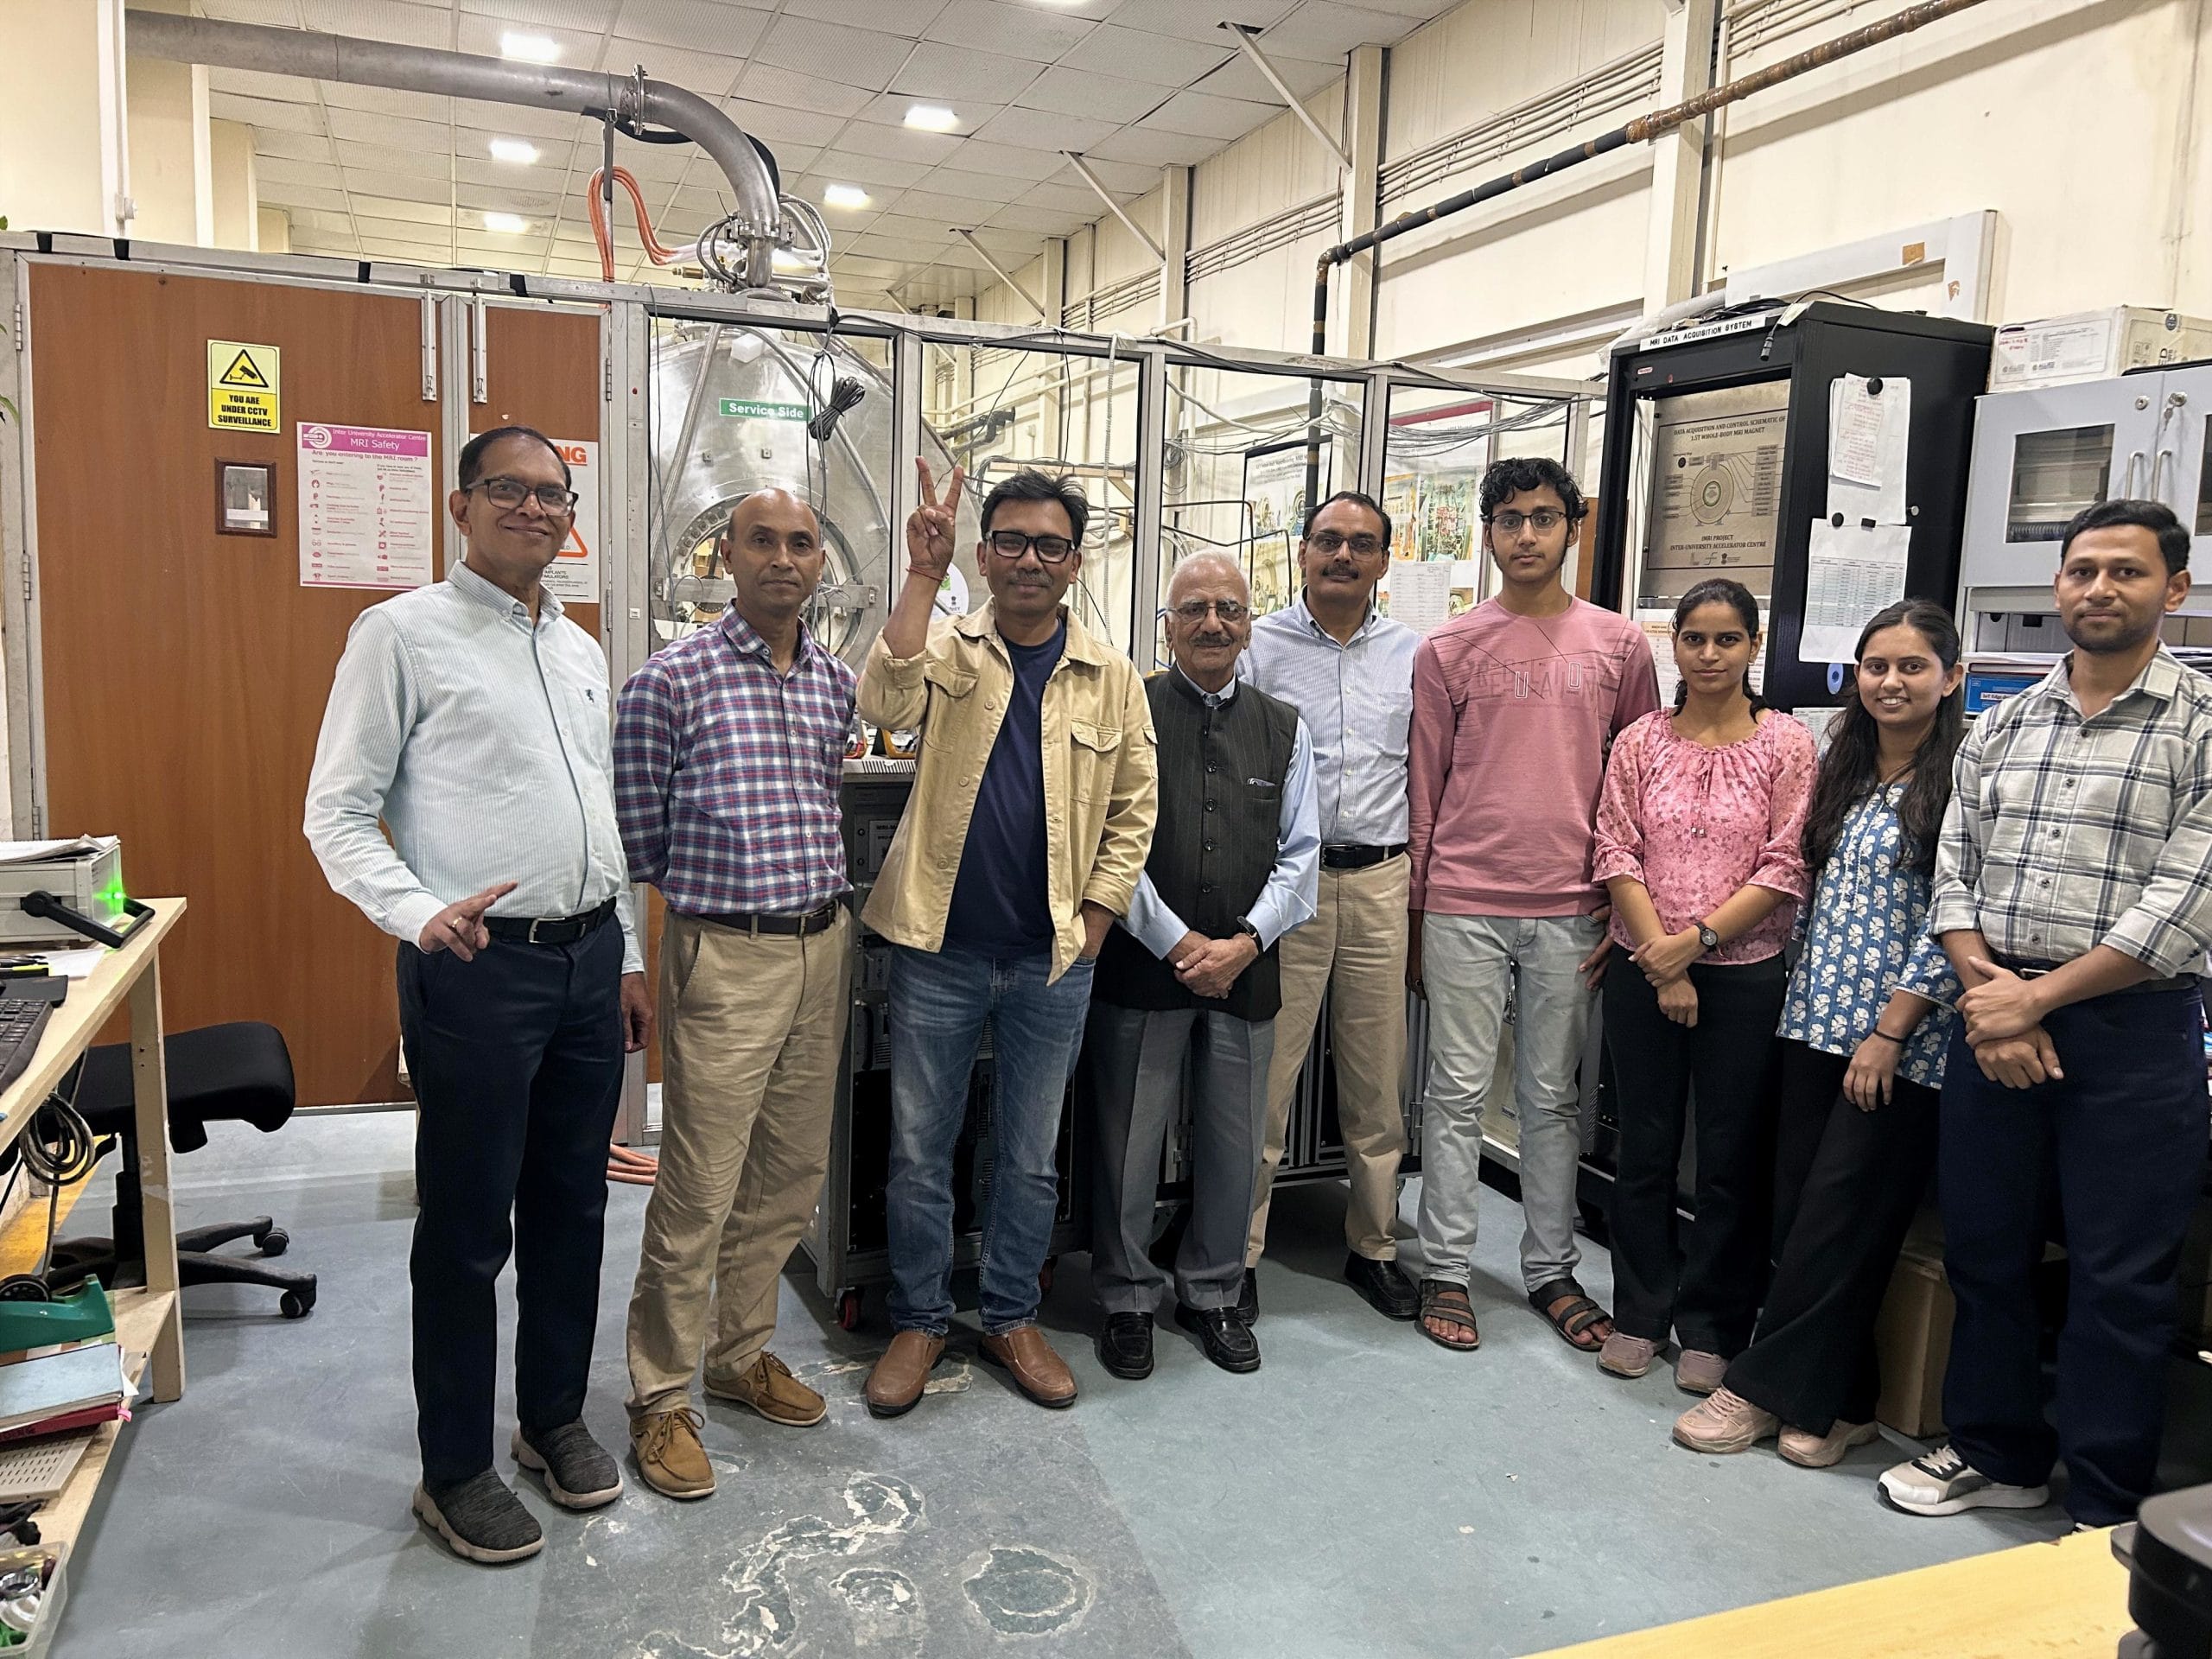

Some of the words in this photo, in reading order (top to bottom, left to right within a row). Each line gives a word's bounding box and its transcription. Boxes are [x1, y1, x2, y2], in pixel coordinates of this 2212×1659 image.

[1662, 335, 1679, 344] DATA
[1683, 327, 1722, 340] ACQUISITION
[1725, 320, 1752, 332] SYSTEM
[229, 394, 244, 404] YOU
[245, 397, 260, 405] ARE
[221, 404, 245, 414] UNDER
[247, 406, 268, 416] CCTV
[728, 403, 775, 416] Service
[779, 406, 804, 418] Side
[218, 415, 271, 427] SURVEILLANCE
[1673, 427, 1686, 435] DATA
[1686, 424, 1715, 434] ACQUISITION
[1726, 420, 1750, 429] CONTROL
[1751, 416, 1777, 426] SCHEMATIC
[347, 429, 375, 439] University
[376, 432, 407, 441] Accelerator
[408, 434, 427, 442] Centre
[1745, 427, 1765, 435] MAGNET
[350, 438, 369, 448] MRI
[372, 440, 400, 451] Safety
